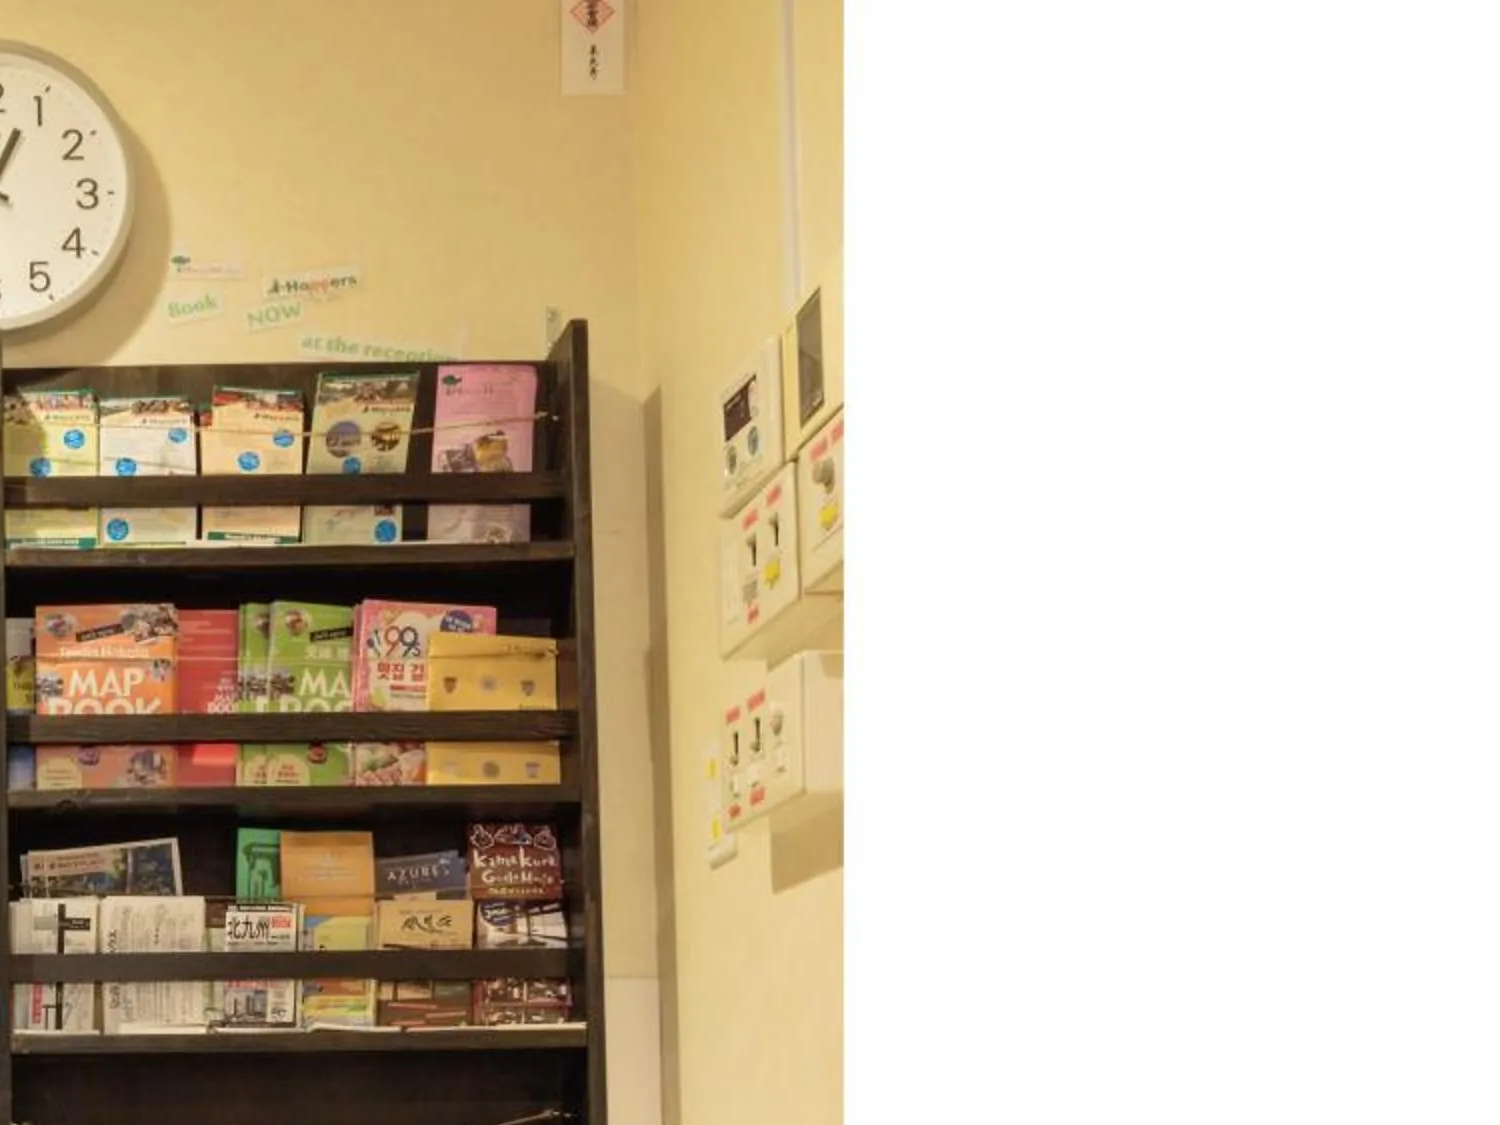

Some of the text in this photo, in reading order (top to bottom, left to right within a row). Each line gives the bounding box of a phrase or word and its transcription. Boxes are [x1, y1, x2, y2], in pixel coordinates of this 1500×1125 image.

[33, 95, 43, 127] 1
[61, 129, 85, 160] 2
[75, 178, 100, 210] 3
[61, 227, 85, 258] 4
[29, 262, 51, 292] 5
[167, 295, 217, 318] Book
[247, 302, 301, 328] NOW
[326, 336, 360, 355] the
[67, 667, 145, 698] MAP
[228, 915, 269, 940] 北九州
